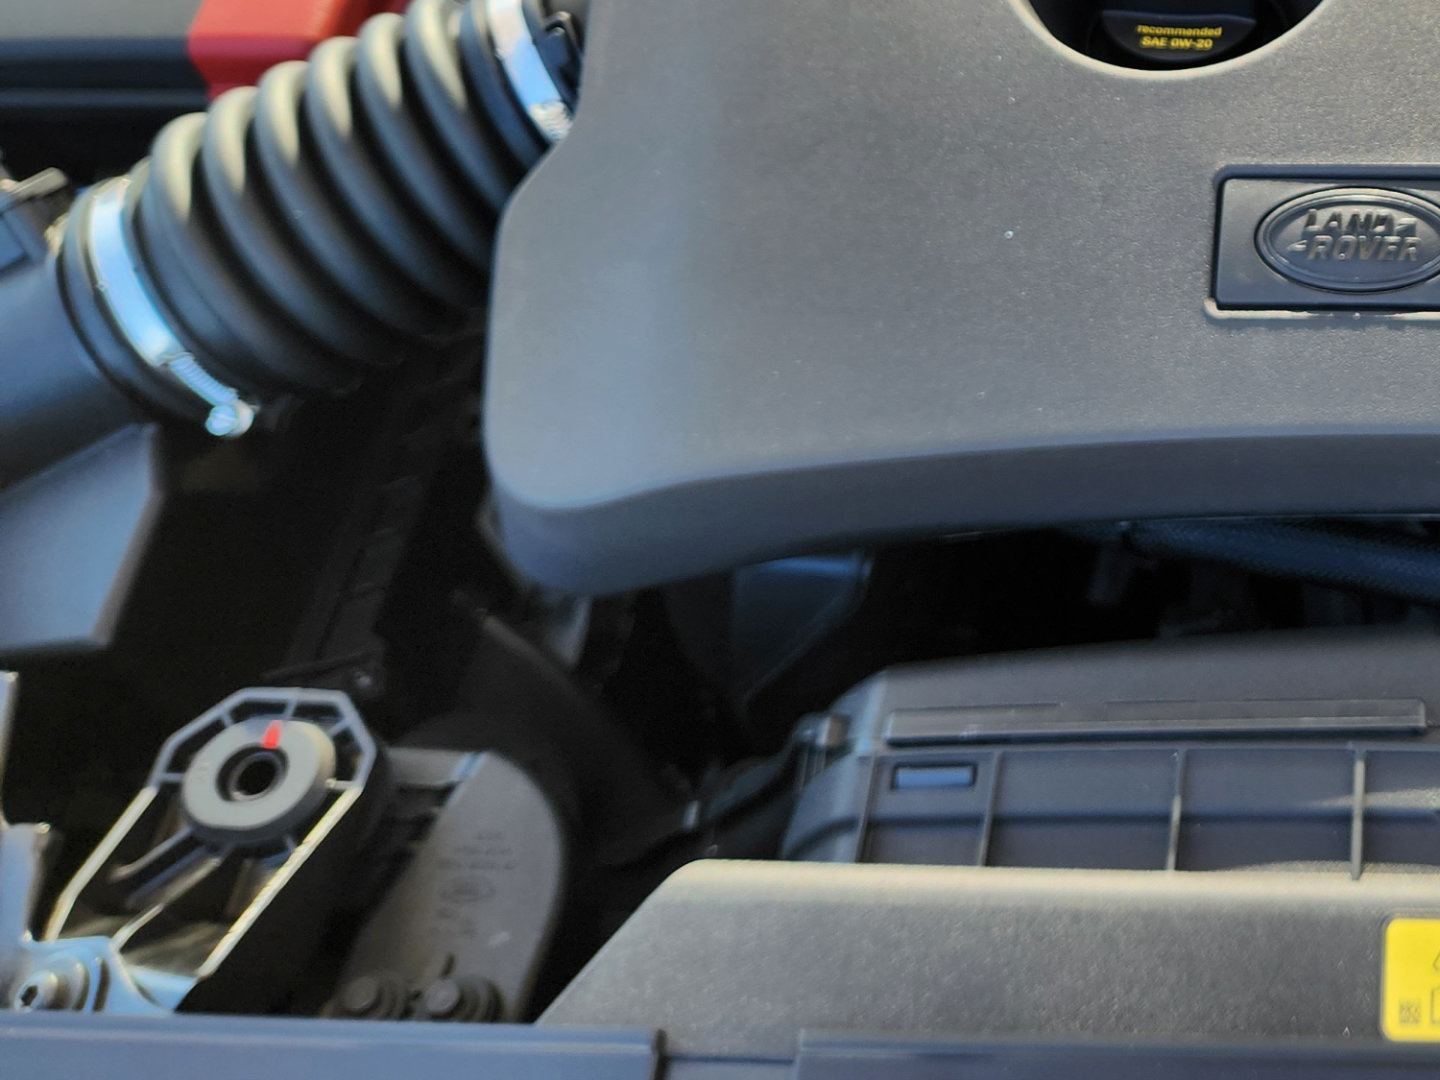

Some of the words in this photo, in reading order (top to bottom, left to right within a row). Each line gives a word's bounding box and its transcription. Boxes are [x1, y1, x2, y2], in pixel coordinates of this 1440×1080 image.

[1136, 25, 1222, 37] recommended
[1142, 36, 1167, 48] SAE
[1170, 37, 1214, 50] 0W-20
[1302, 208, 1395, 232] LAND
[1306, 234, 1422, 261] ROVER
